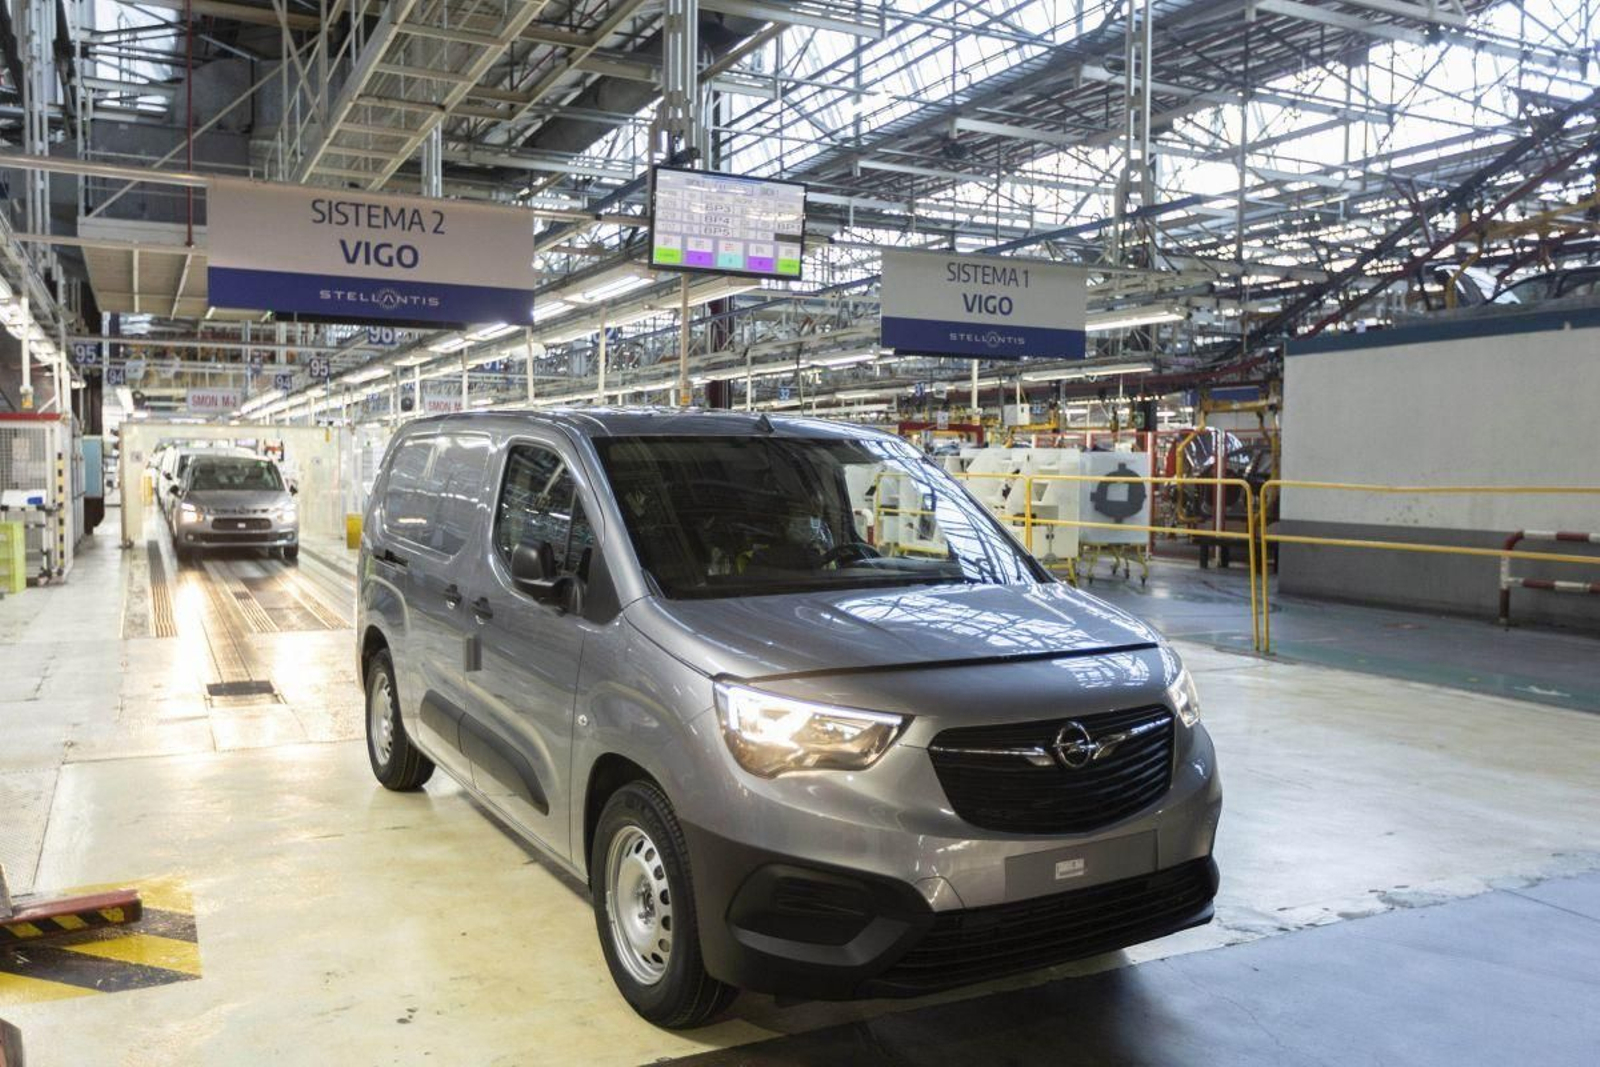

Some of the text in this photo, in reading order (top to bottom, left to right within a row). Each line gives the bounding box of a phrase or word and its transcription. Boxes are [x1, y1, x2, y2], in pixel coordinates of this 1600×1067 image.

[311, 199, 445, 235] SISTEMA 2
[340, 239, 420, 269] VIGO
[946, 262, 1030, 288] SISTEMA 1
[319, 289, 440, 308] STELLANTIS
[962, 293, 1013, 316] VIGO
[370, 325, 393, 343] 96
[949, 331, 1025, 347] STELLANTIS
[75, 345, 96, 363] 95
[109, 370, 124, 384] 94
[310, 360, 329, 377] 95
